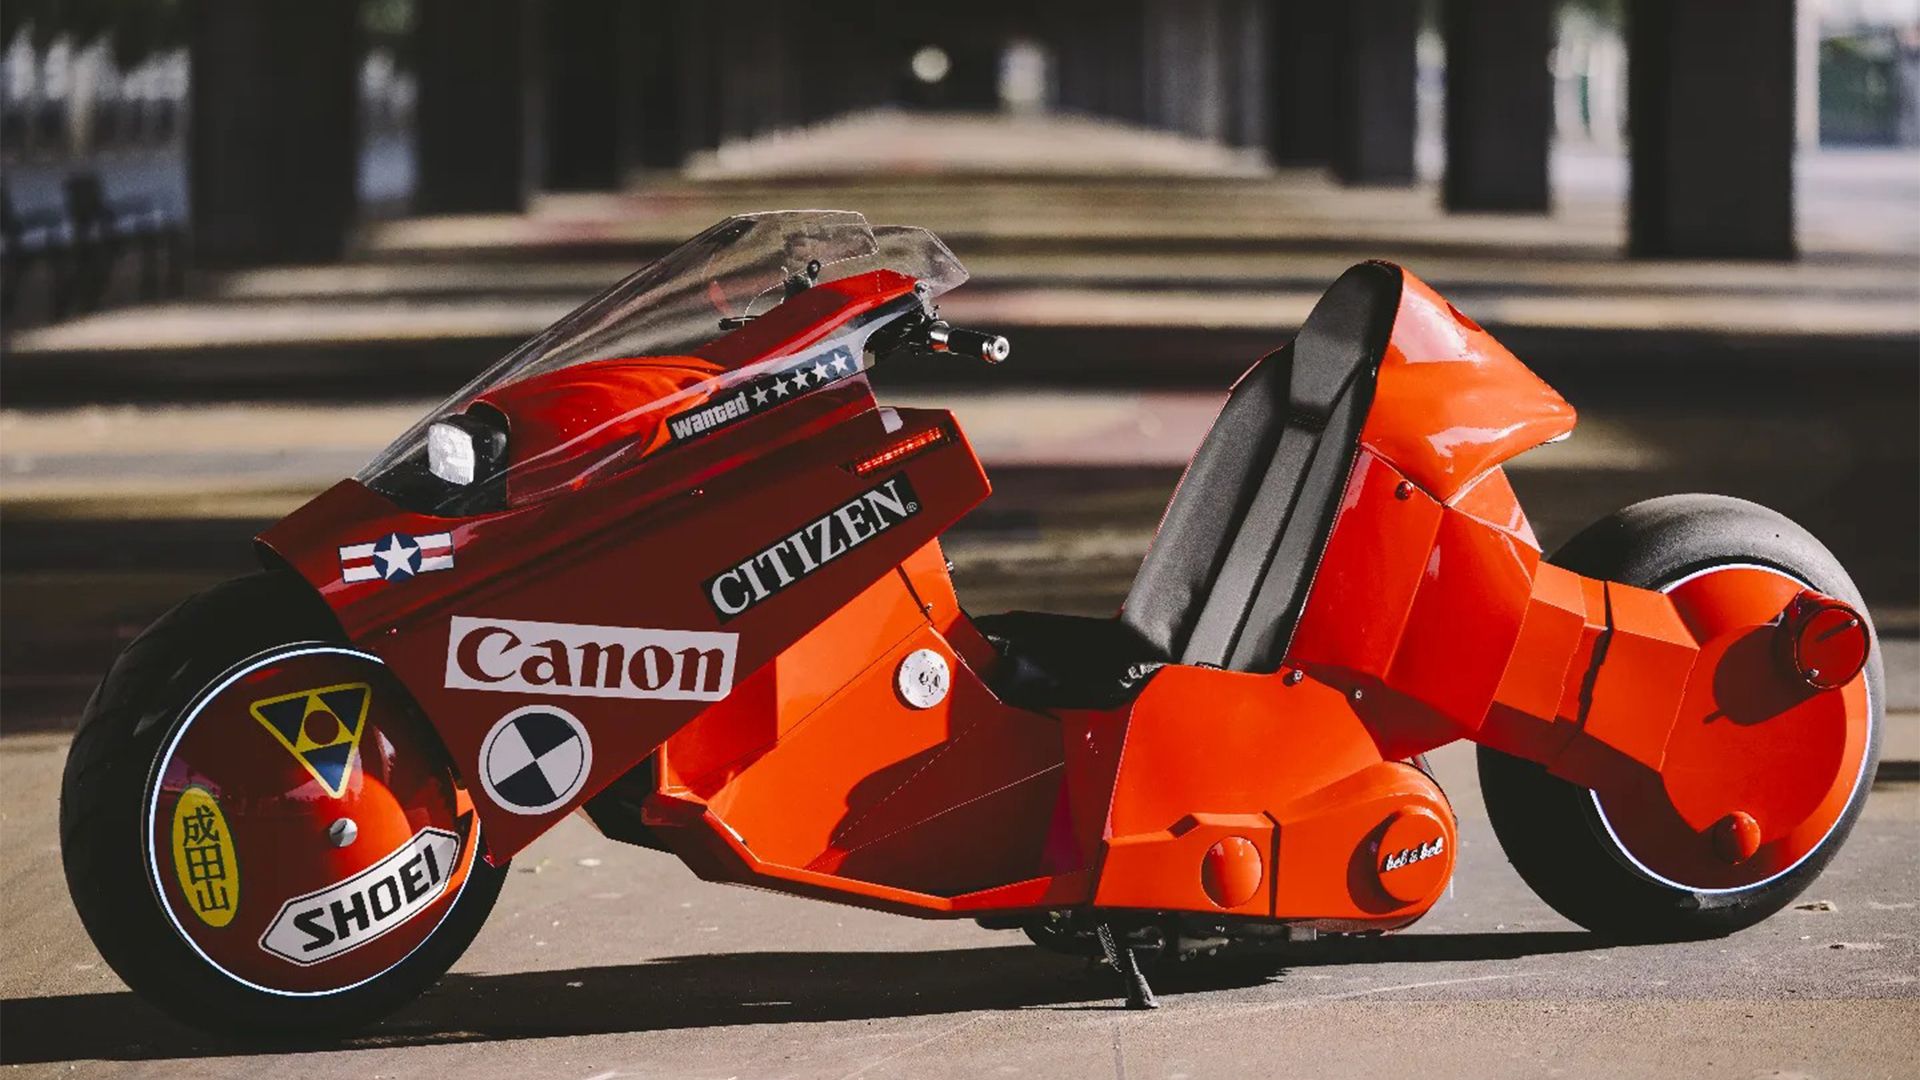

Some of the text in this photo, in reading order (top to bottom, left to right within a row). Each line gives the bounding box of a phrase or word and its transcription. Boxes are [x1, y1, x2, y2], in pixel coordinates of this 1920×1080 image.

[456, 625, 725, 693] Canon
[182, 806, 231, 913] 成田山
[293, 845, 441, 952] SHOEI
